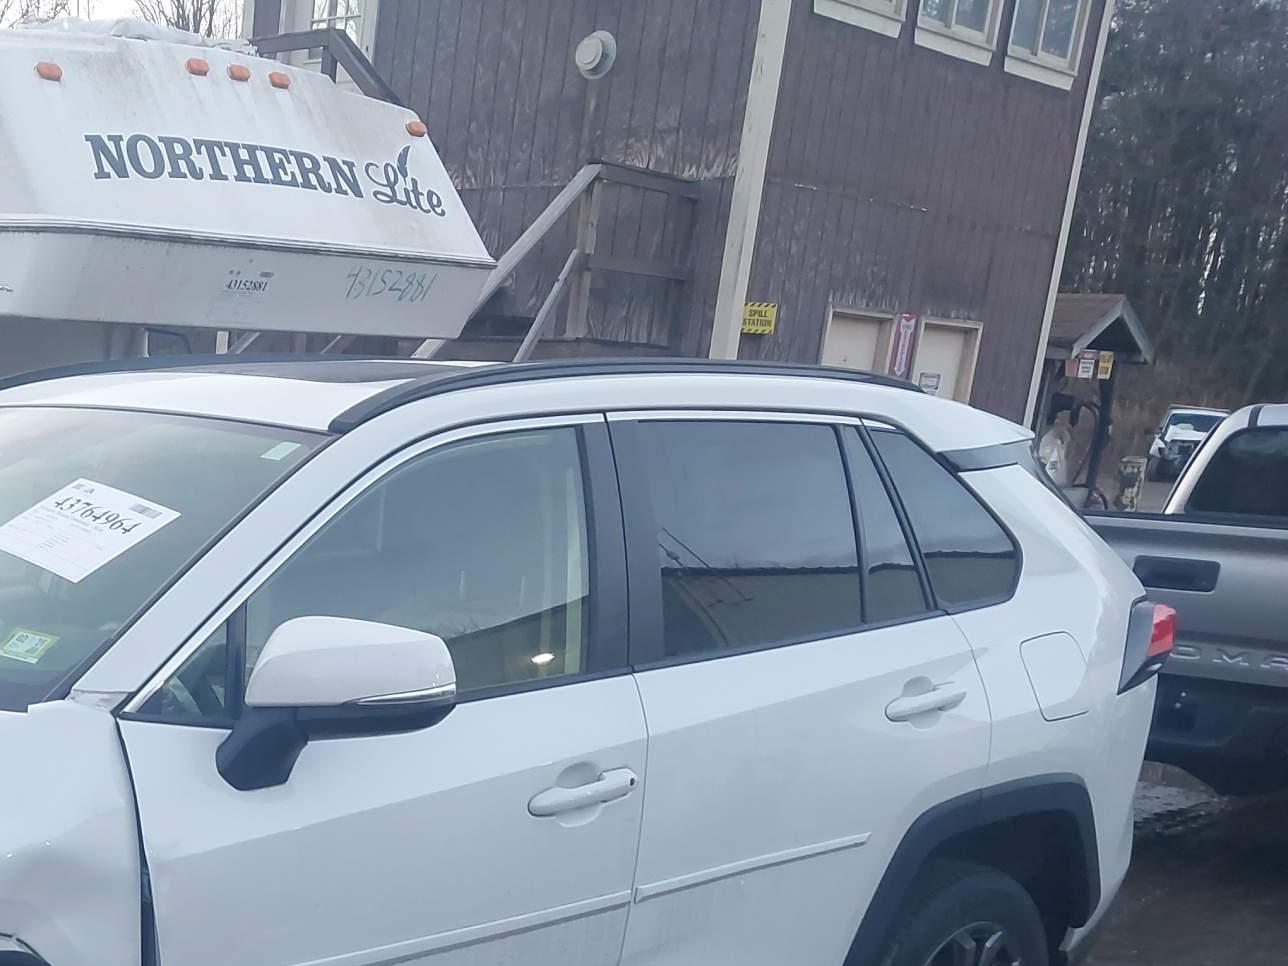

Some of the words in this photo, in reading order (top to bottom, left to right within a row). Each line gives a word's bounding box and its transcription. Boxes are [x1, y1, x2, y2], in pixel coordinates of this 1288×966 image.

[84, 134, 364, 199] NORTHERN
[364, 145, 446, 218] Lite
[225, 279, 269, 292] 43152881
[344, 265, 439, 302] 43152881
[748, 309, 769, 318] SPILL
[53, 496, 142, 535] 43764964
